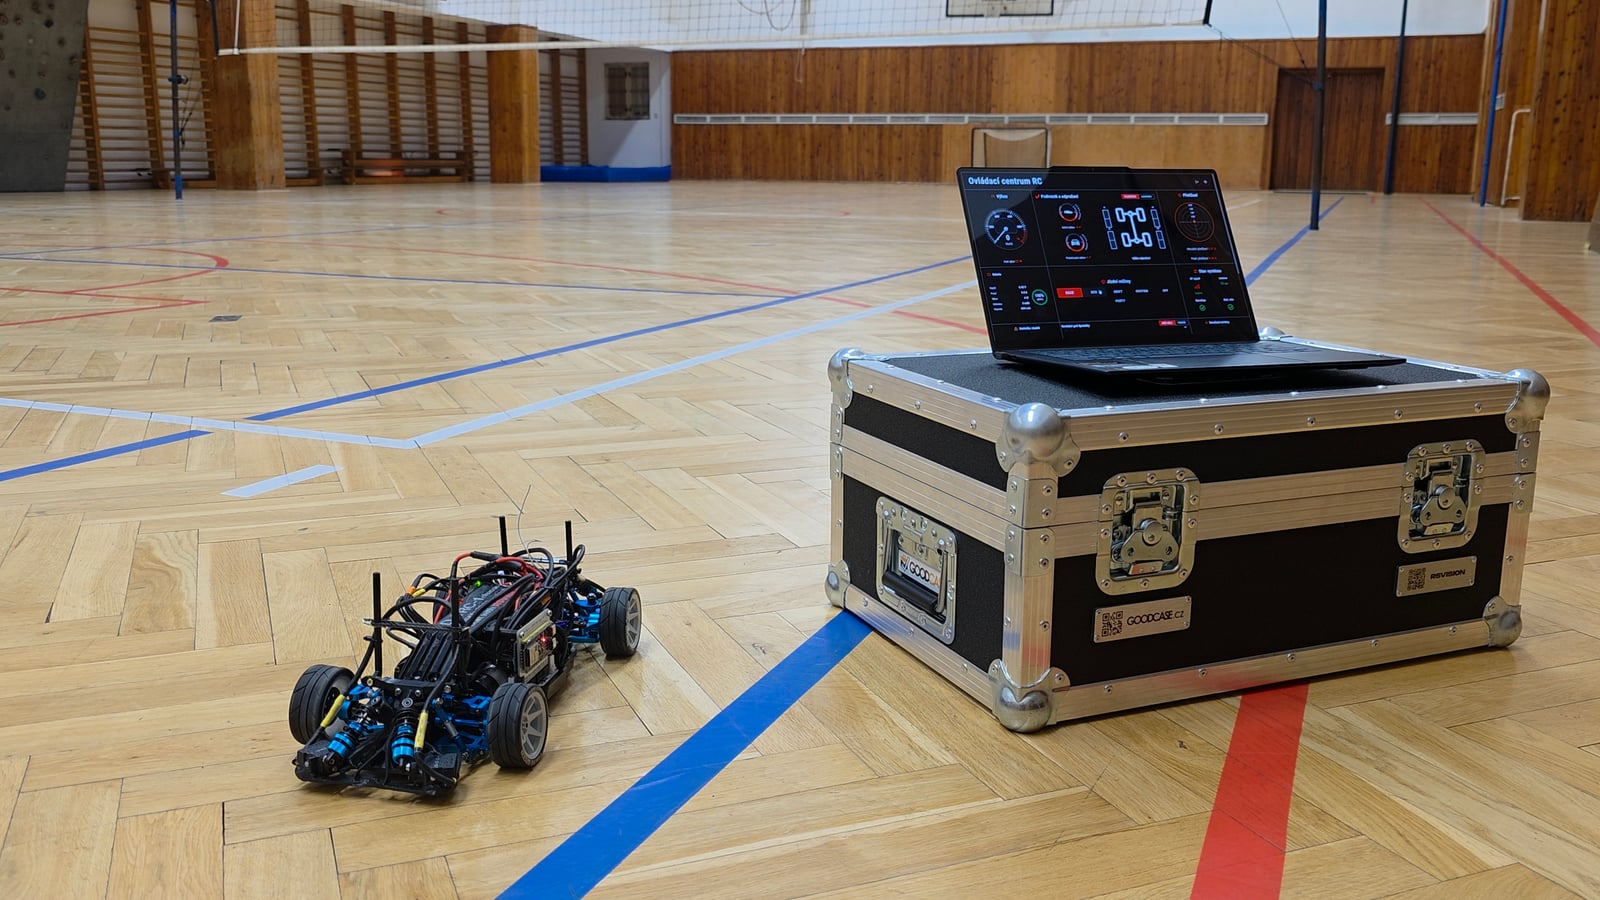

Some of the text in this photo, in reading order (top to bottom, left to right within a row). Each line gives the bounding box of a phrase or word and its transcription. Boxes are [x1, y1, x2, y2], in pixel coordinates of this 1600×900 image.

[968, 176, 1043, 186] Ovládací centrum RC
[909, 561, 940, 586] GOODCA
